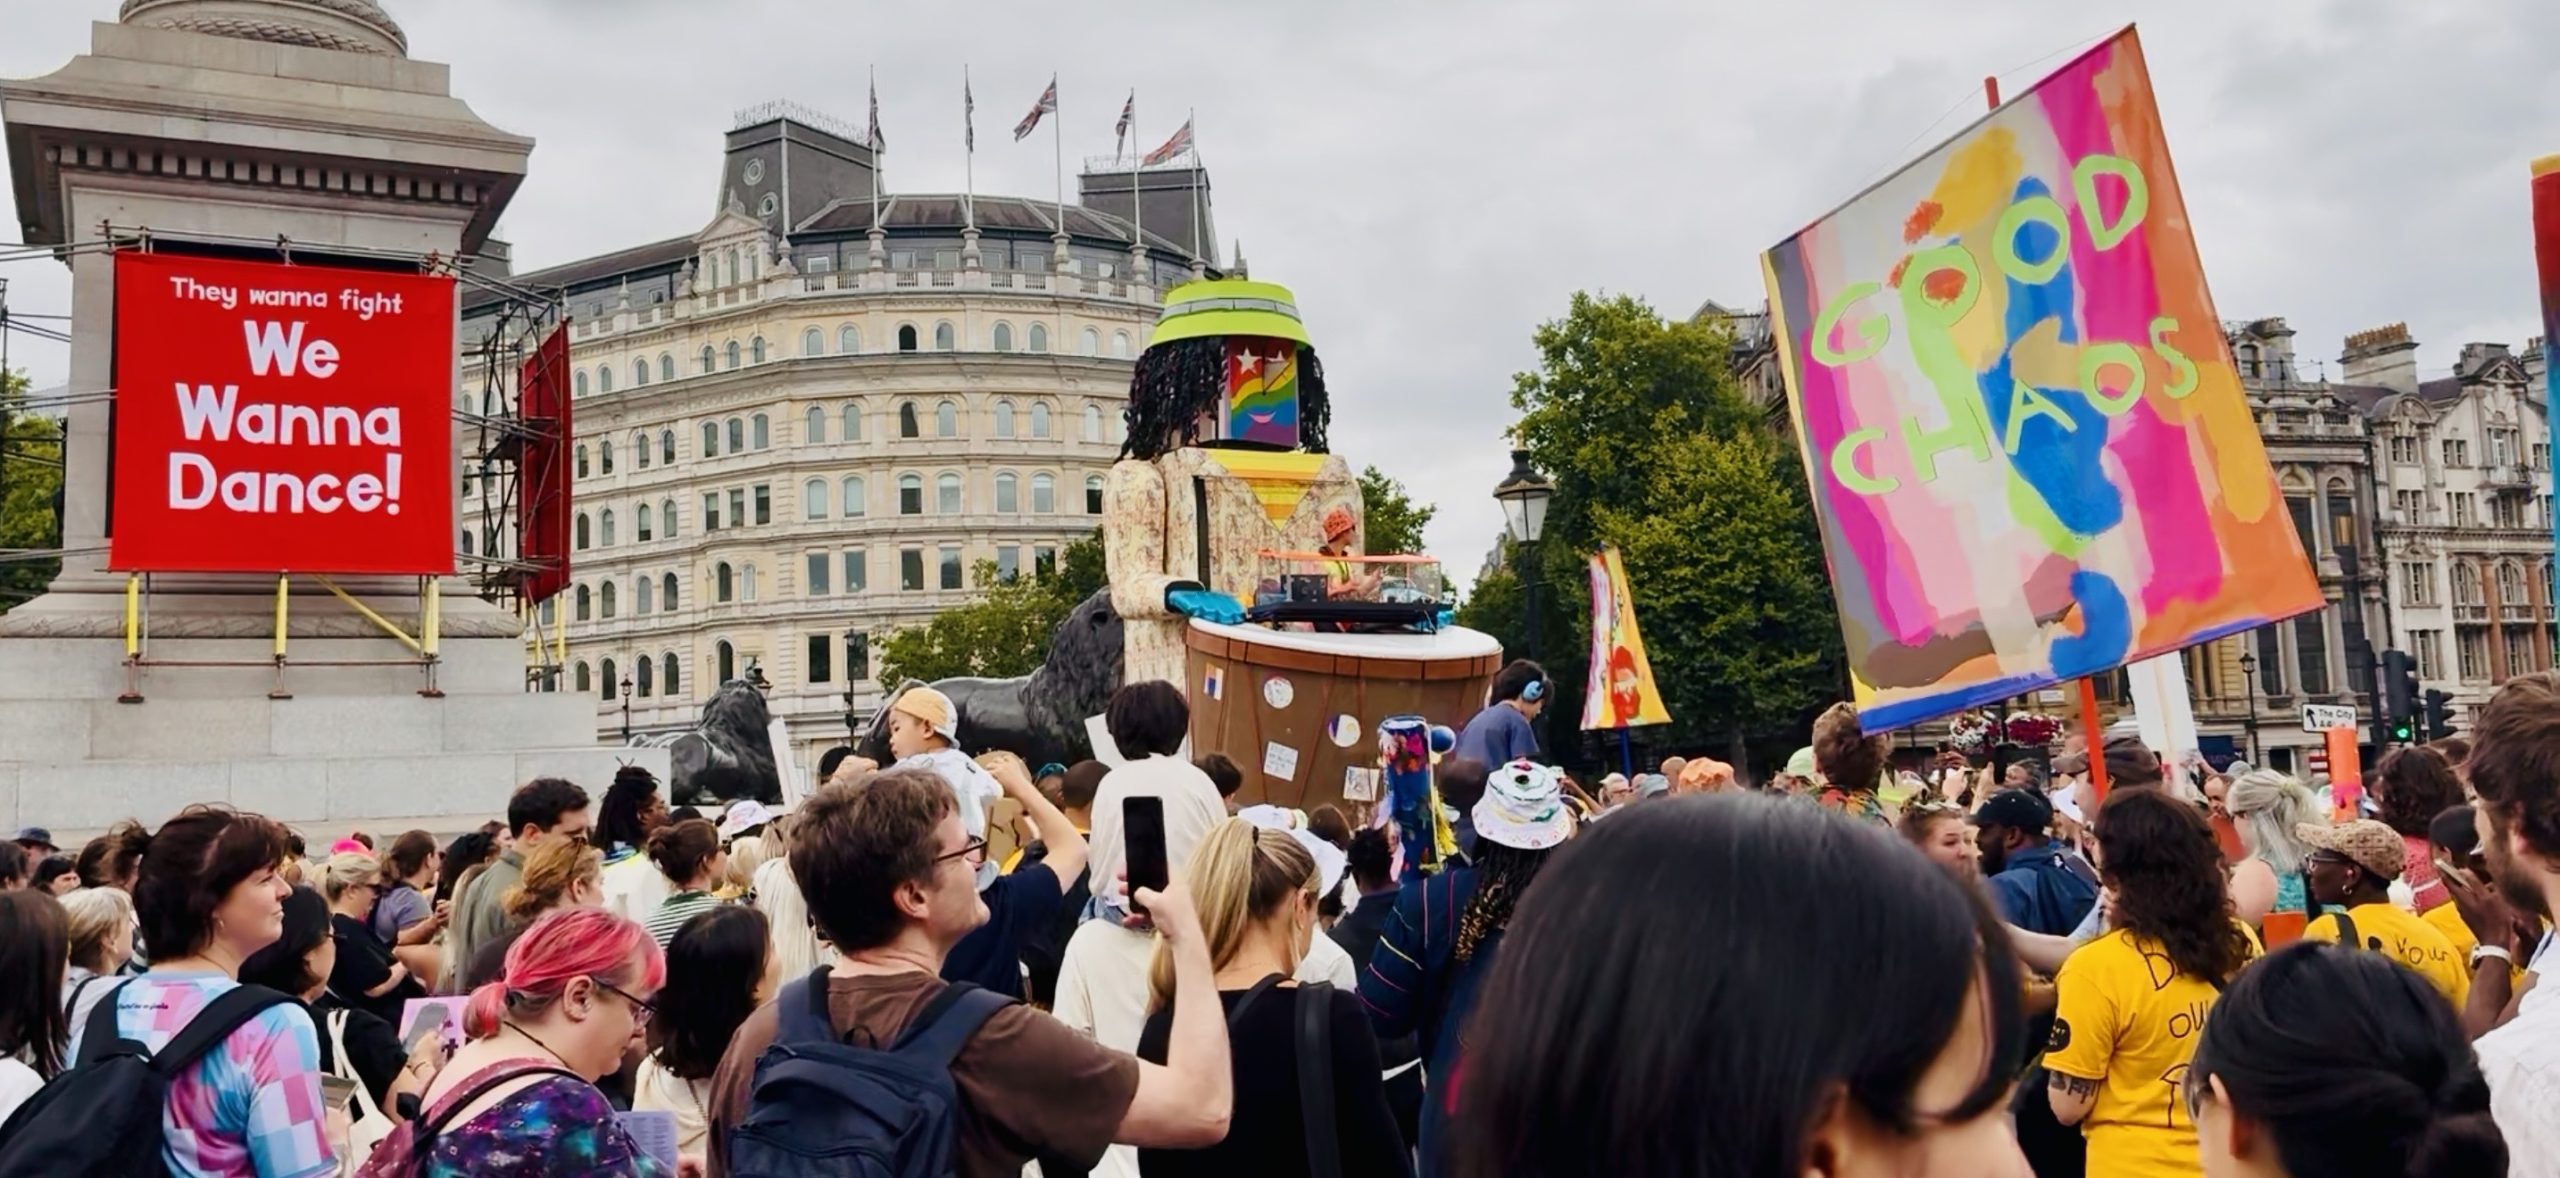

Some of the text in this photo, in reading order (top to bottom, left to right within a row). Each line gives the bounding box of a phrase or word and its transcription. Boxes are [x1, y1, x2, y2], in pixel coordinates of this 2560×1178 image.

[1811, 153, 2149, 368] GOOD
[169, 276, 403, 320] They wanna fight
[243, 319, 340, 379] We
[174, 382, 401, 447] Wanna
[1830, 316, 2200, 496] CHAOS
[168, 451, 403, 516] Dance!
[2319, 708, 2353, 721] The City
